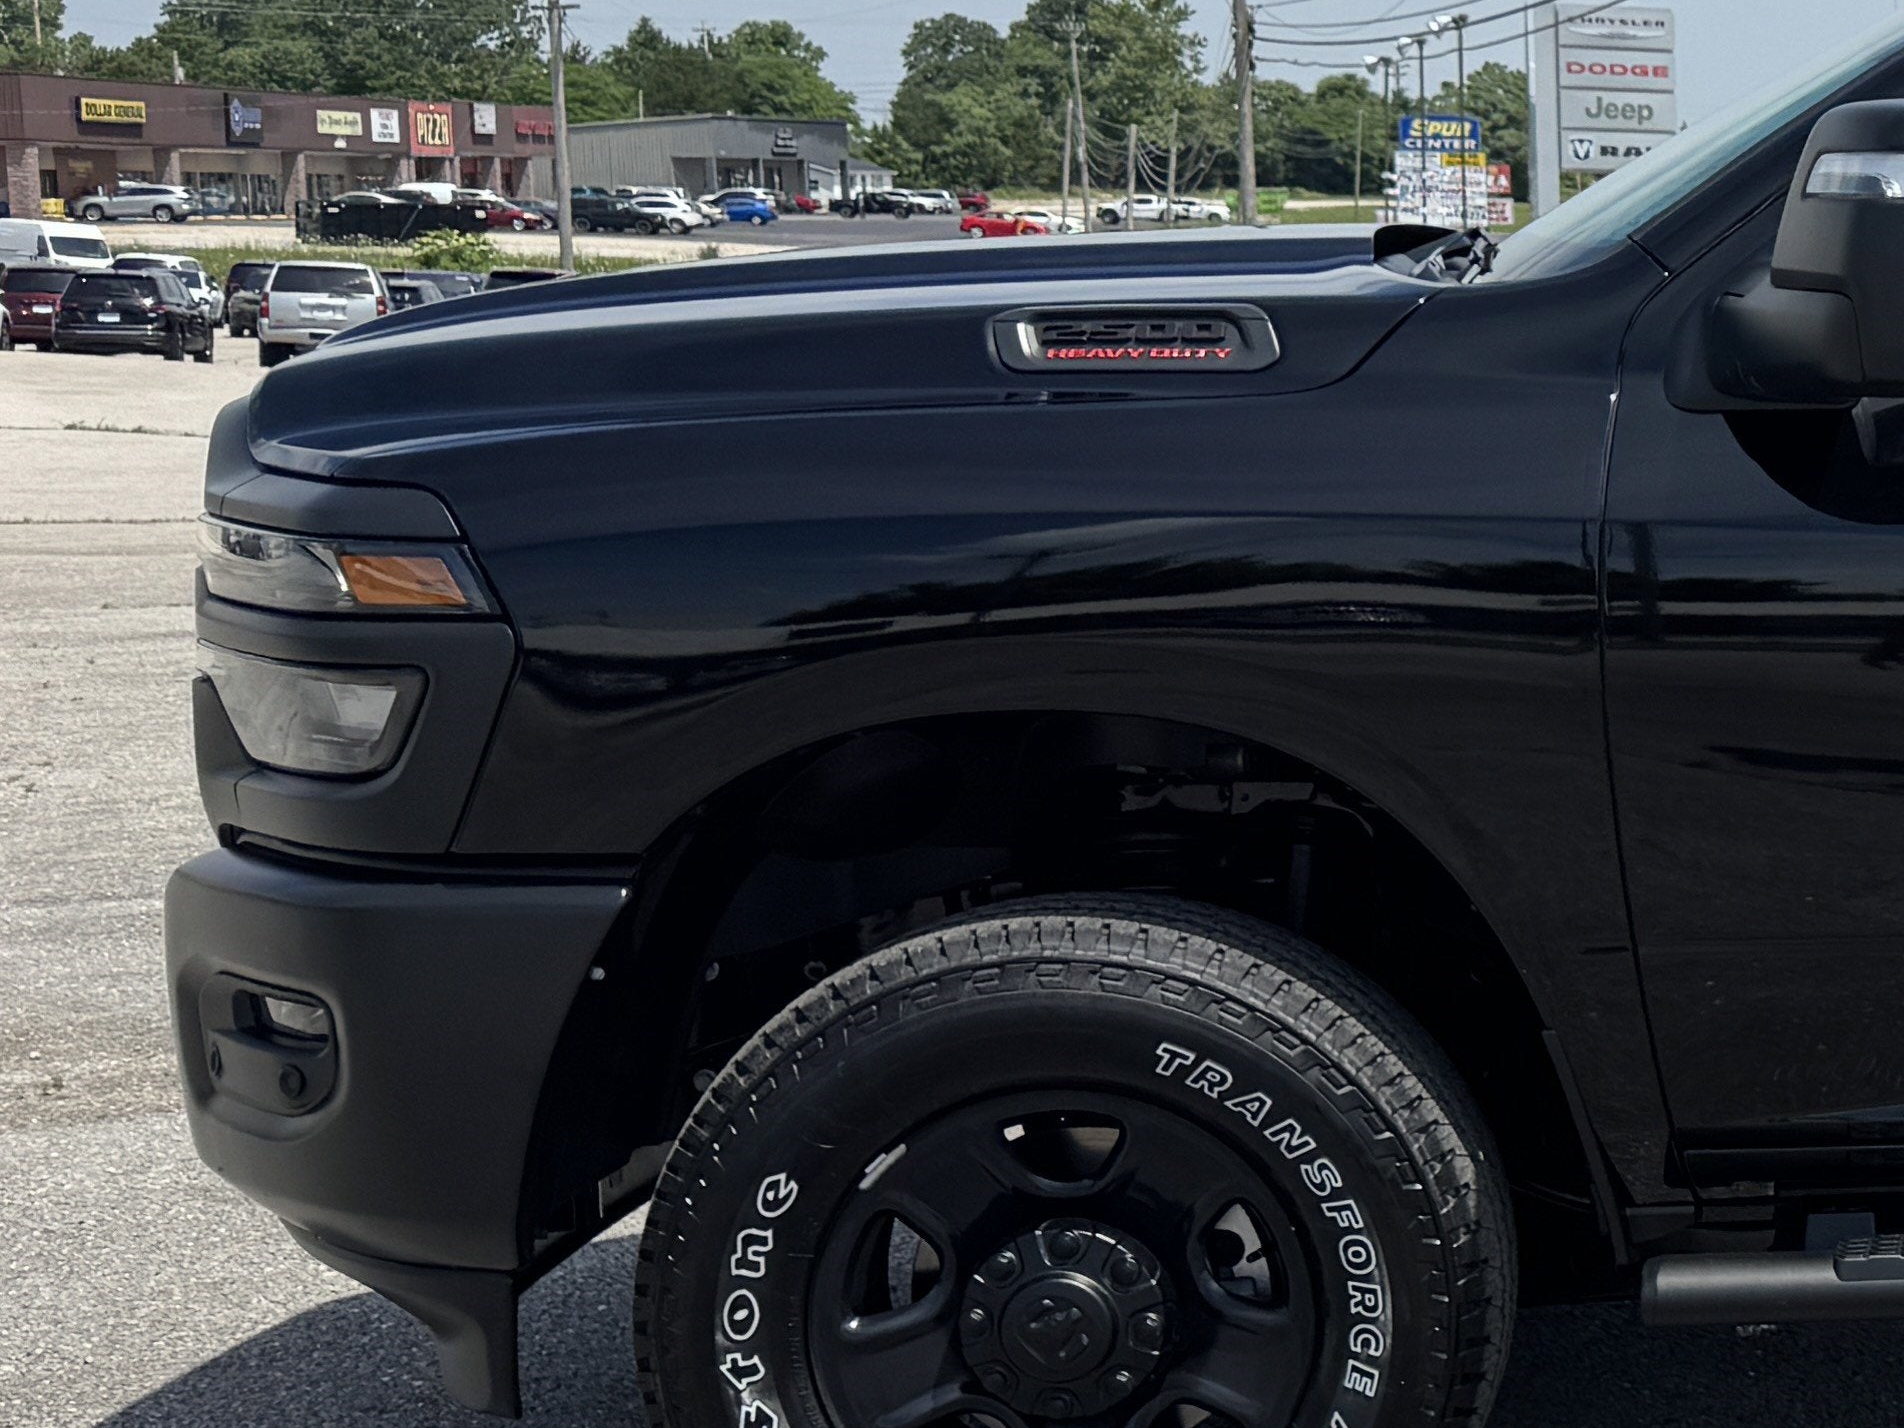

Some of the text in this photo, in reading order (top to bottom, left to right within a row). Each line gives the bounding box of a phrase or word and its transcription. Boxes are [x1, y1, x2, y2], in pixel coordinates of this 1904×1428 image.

[1566, 61, 1669, 78] DODGE
[84, 101, 112, 117] DOLLAR
[1585, 95, 1654, 126] Jeep
[416, 112, 450, 146] PIZZA
[1600, 145, 1652, 158] RA
[1046, 347, 1233, 360] HEAVY DUTY
[1155, 1043, 1386, 1399] TRANSFORCE
